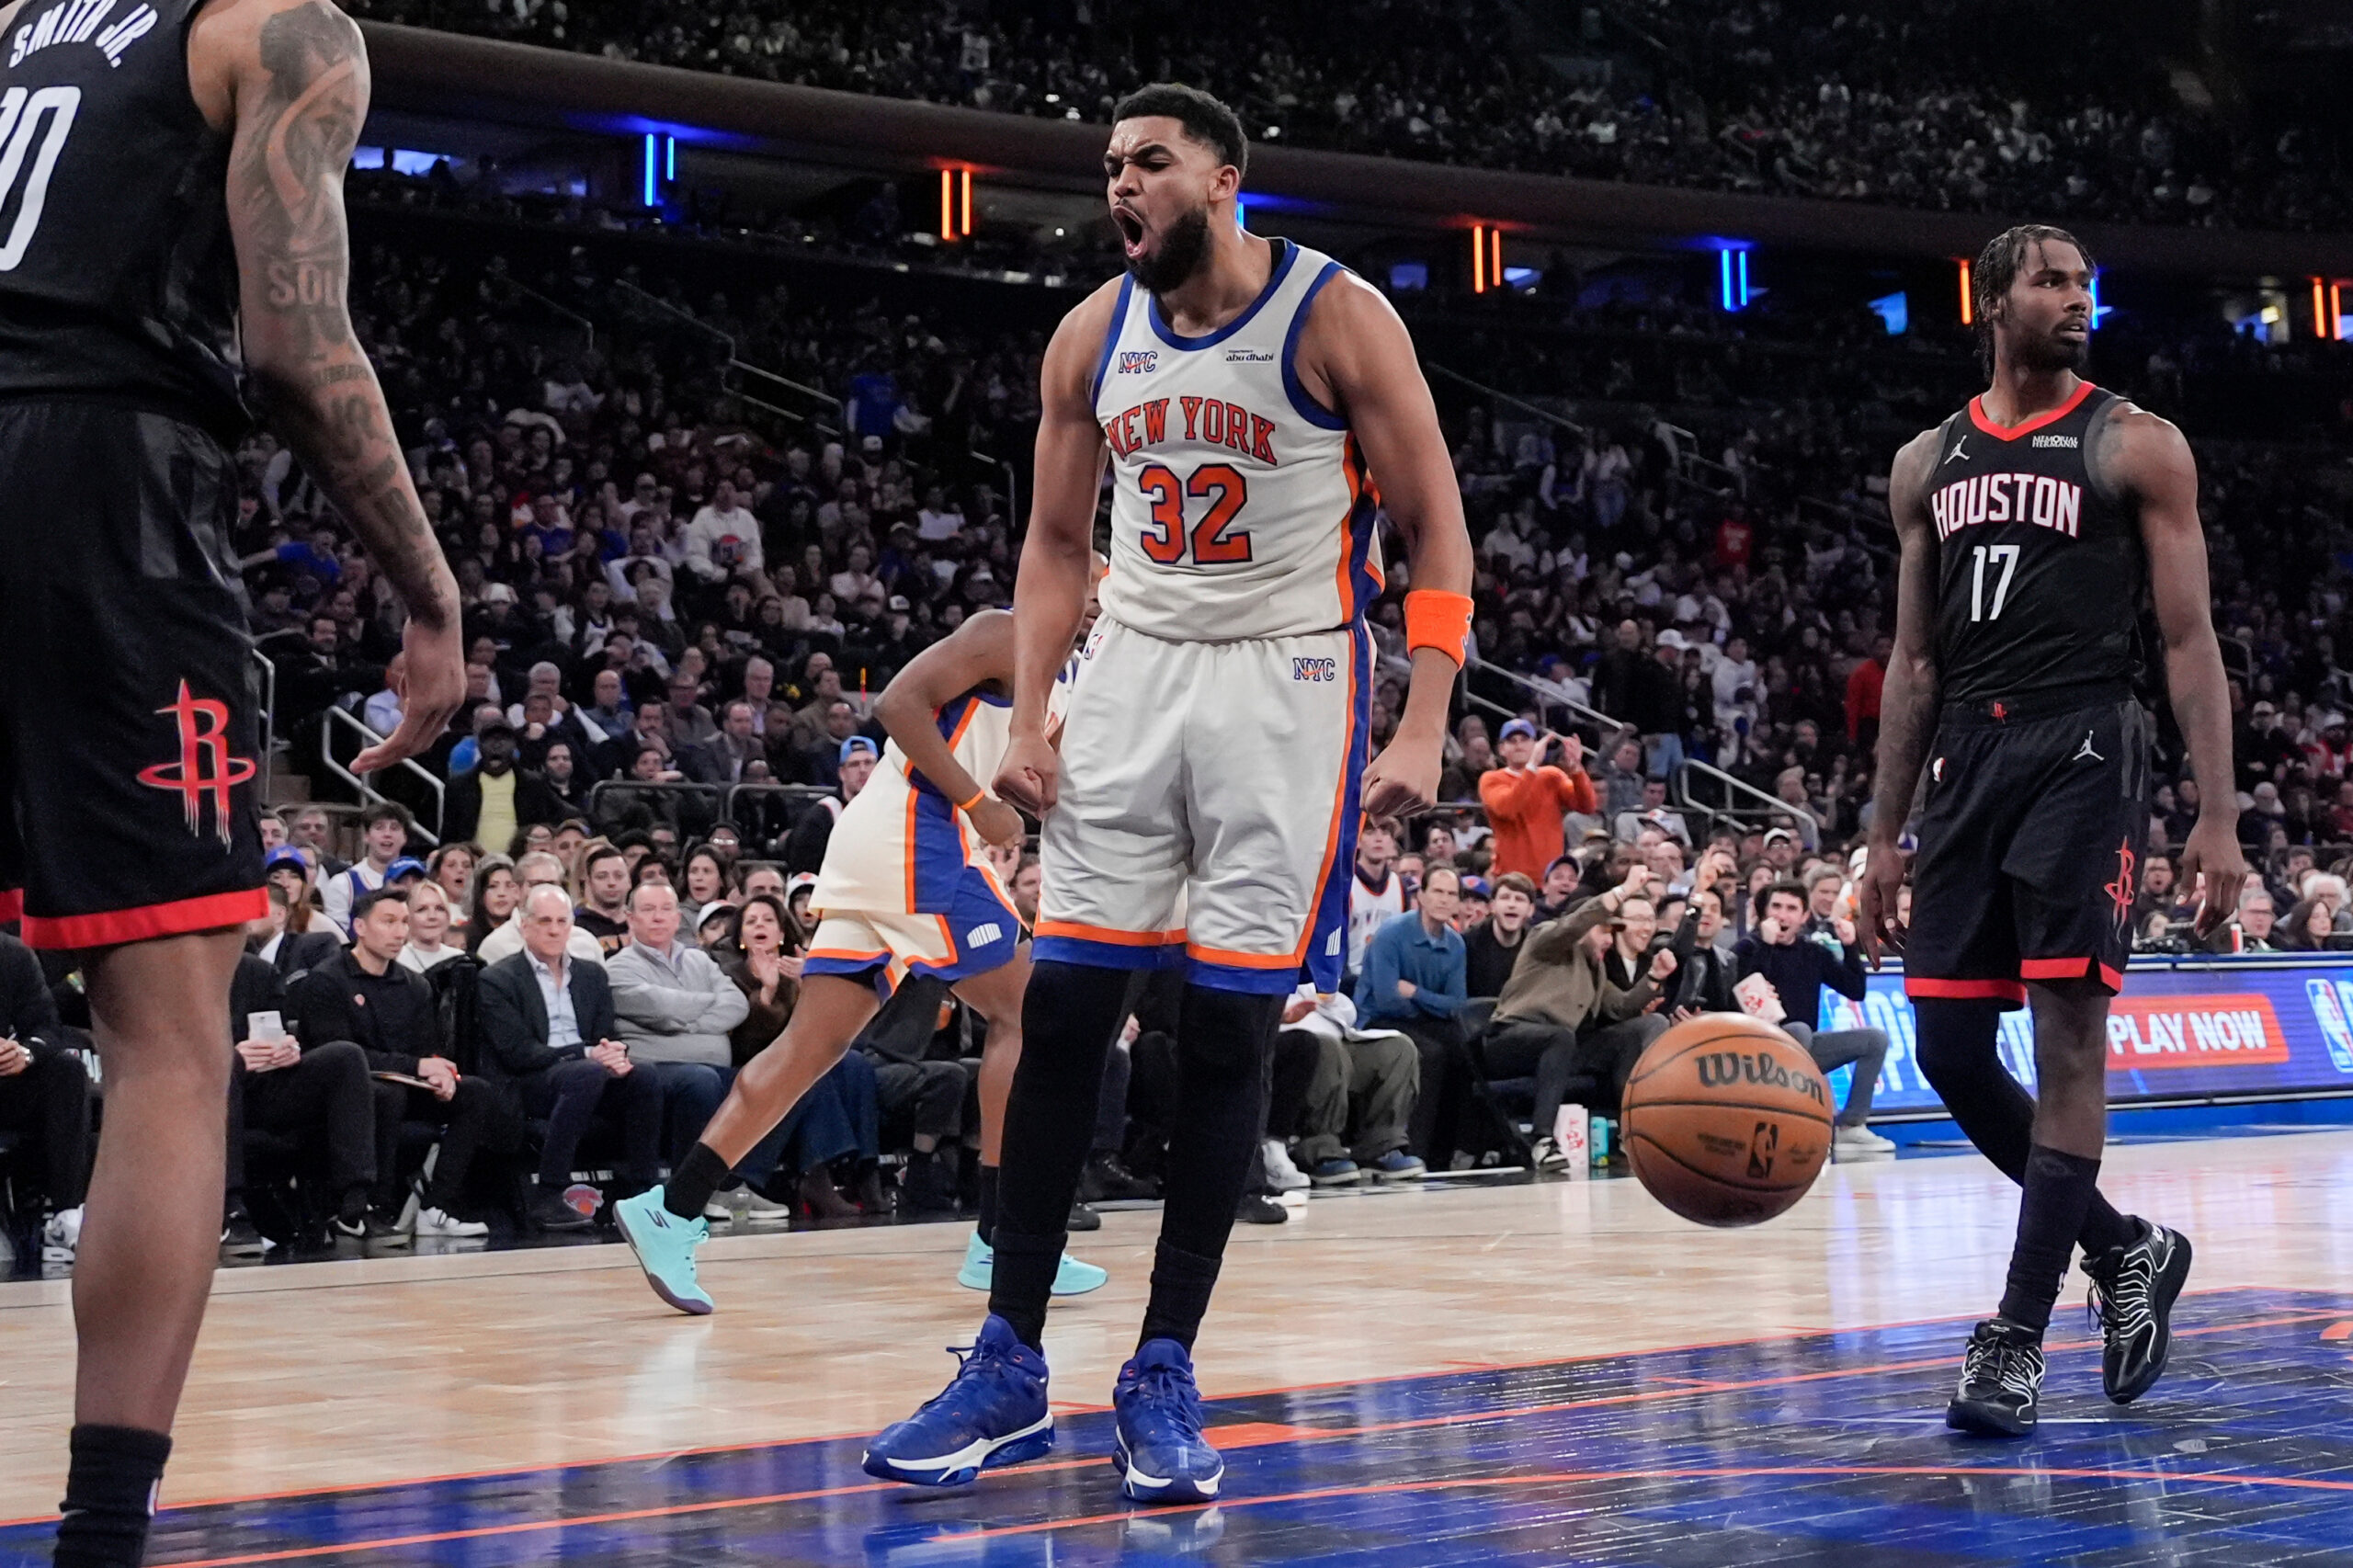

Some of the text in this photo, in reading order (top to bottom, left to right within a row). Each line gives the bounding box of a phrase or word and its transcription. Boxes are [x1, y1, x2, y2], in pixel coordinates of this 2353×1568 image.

[95, 3, 158, 68] JR.
[1119, 351, 1158, 374] NYC
[1226, 353, 1274, 361] abu dhabi
[1105, 396, 1278, 466] NEW YORK
[1138, 462, 1254, 565] 32
[1931, 472, 2083, 543] HOUSTON
[1971, 544, 2021, 622] 17
[1292, 657, 1336, 682] NYC
[2106, 1010, 2268, 1055] PLAY NOW
[1695, 1051, 1825, 1108] Wilson
